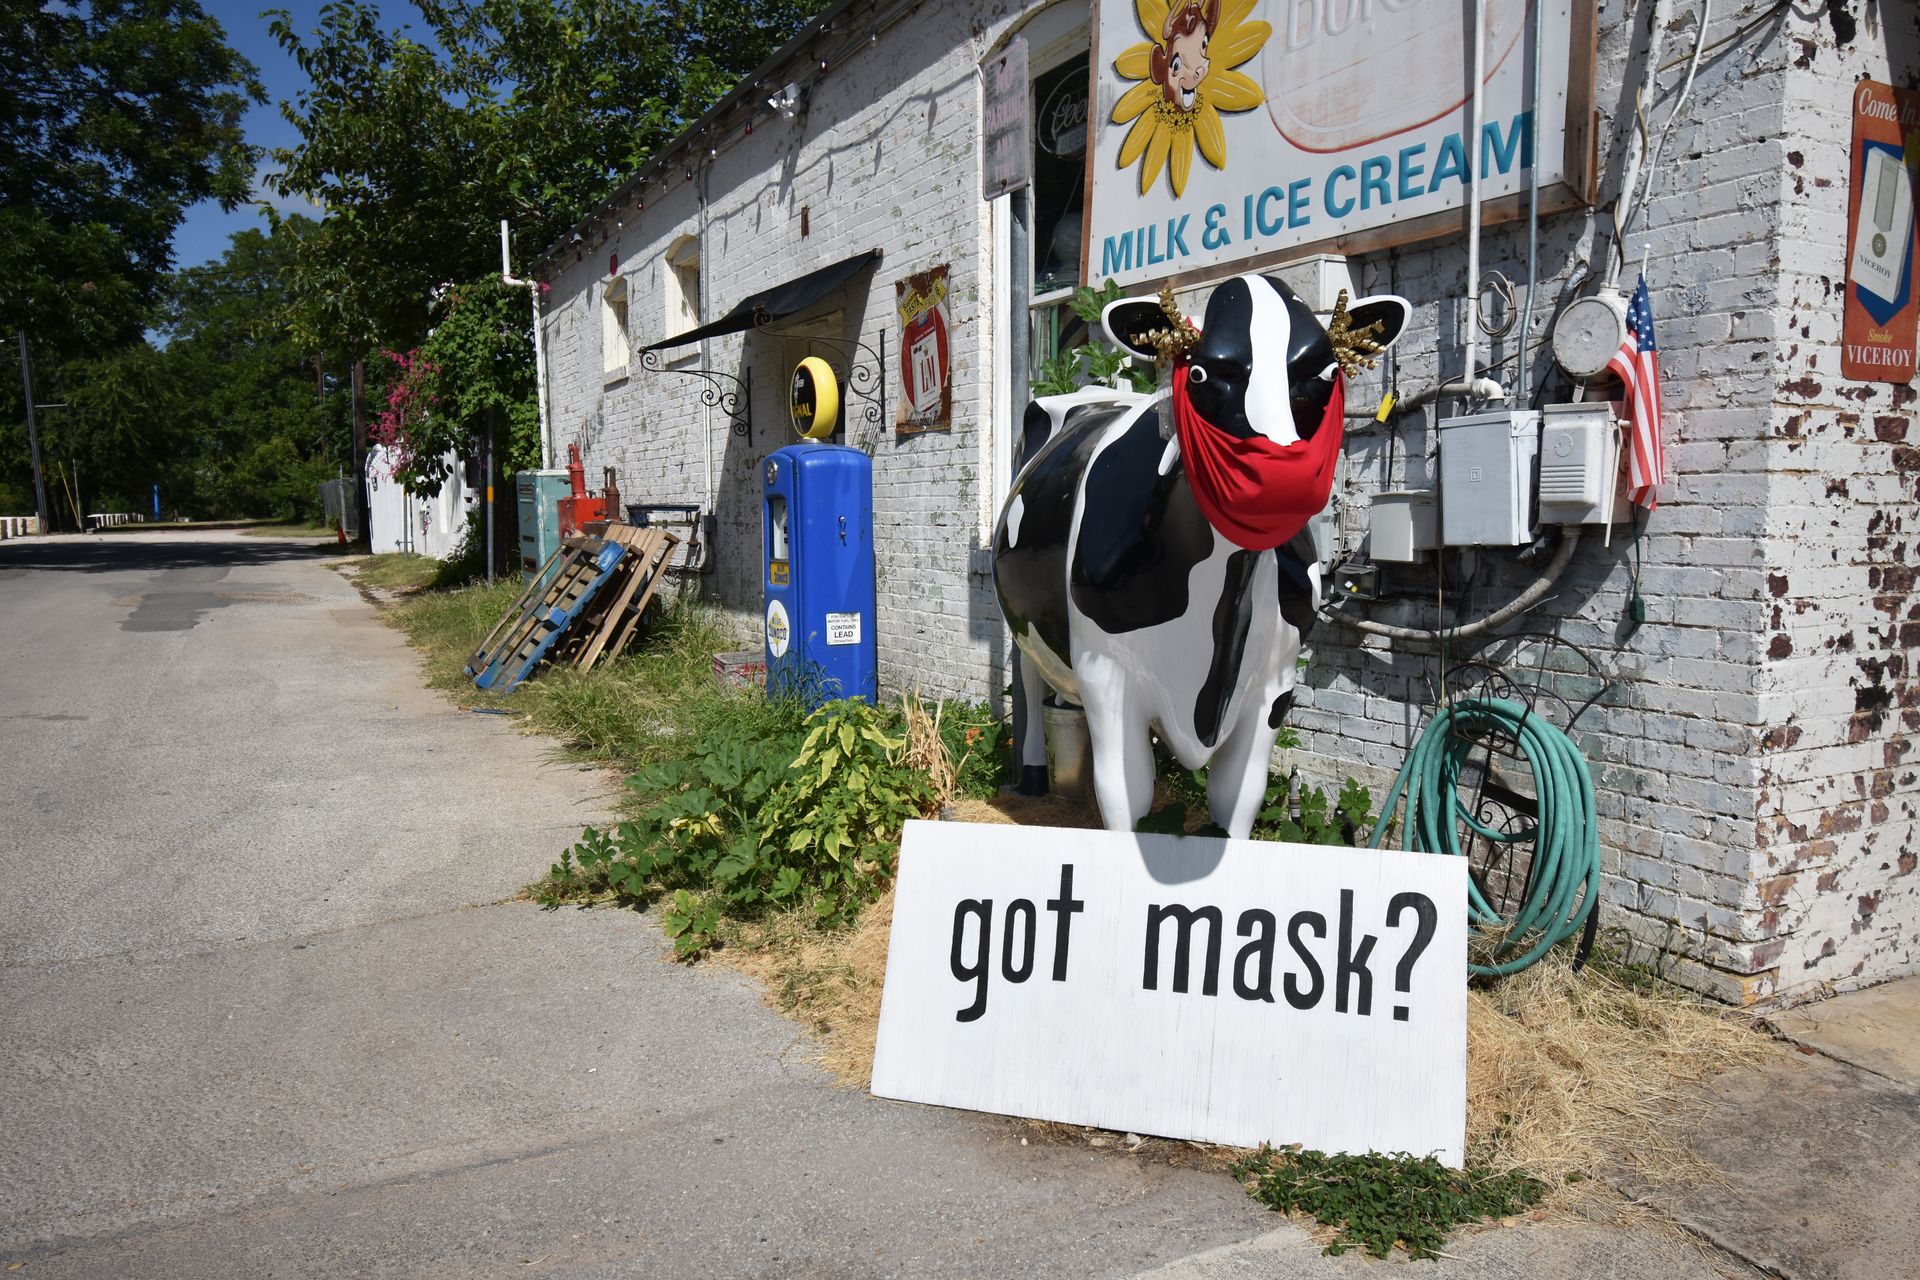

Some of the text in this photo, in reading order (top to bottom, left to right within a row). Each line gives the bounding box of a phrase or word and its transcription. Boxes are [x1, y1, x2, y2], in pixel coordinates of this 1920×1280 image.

[985, 94, 1024, 135] PARKING
[1858, 88, 1897, 121] Come
[1102, 111, 1535, 277] MILK & ICE CREAM
[1860, 254, 1892, 279] VICEROY
[1867, 328, 1893, 344] Smoke
[1847, 344, 1912, 367] VICEROY
[834, 630, 854, 639] LEAD
[950, 863, 1438, 1023] got mask?
